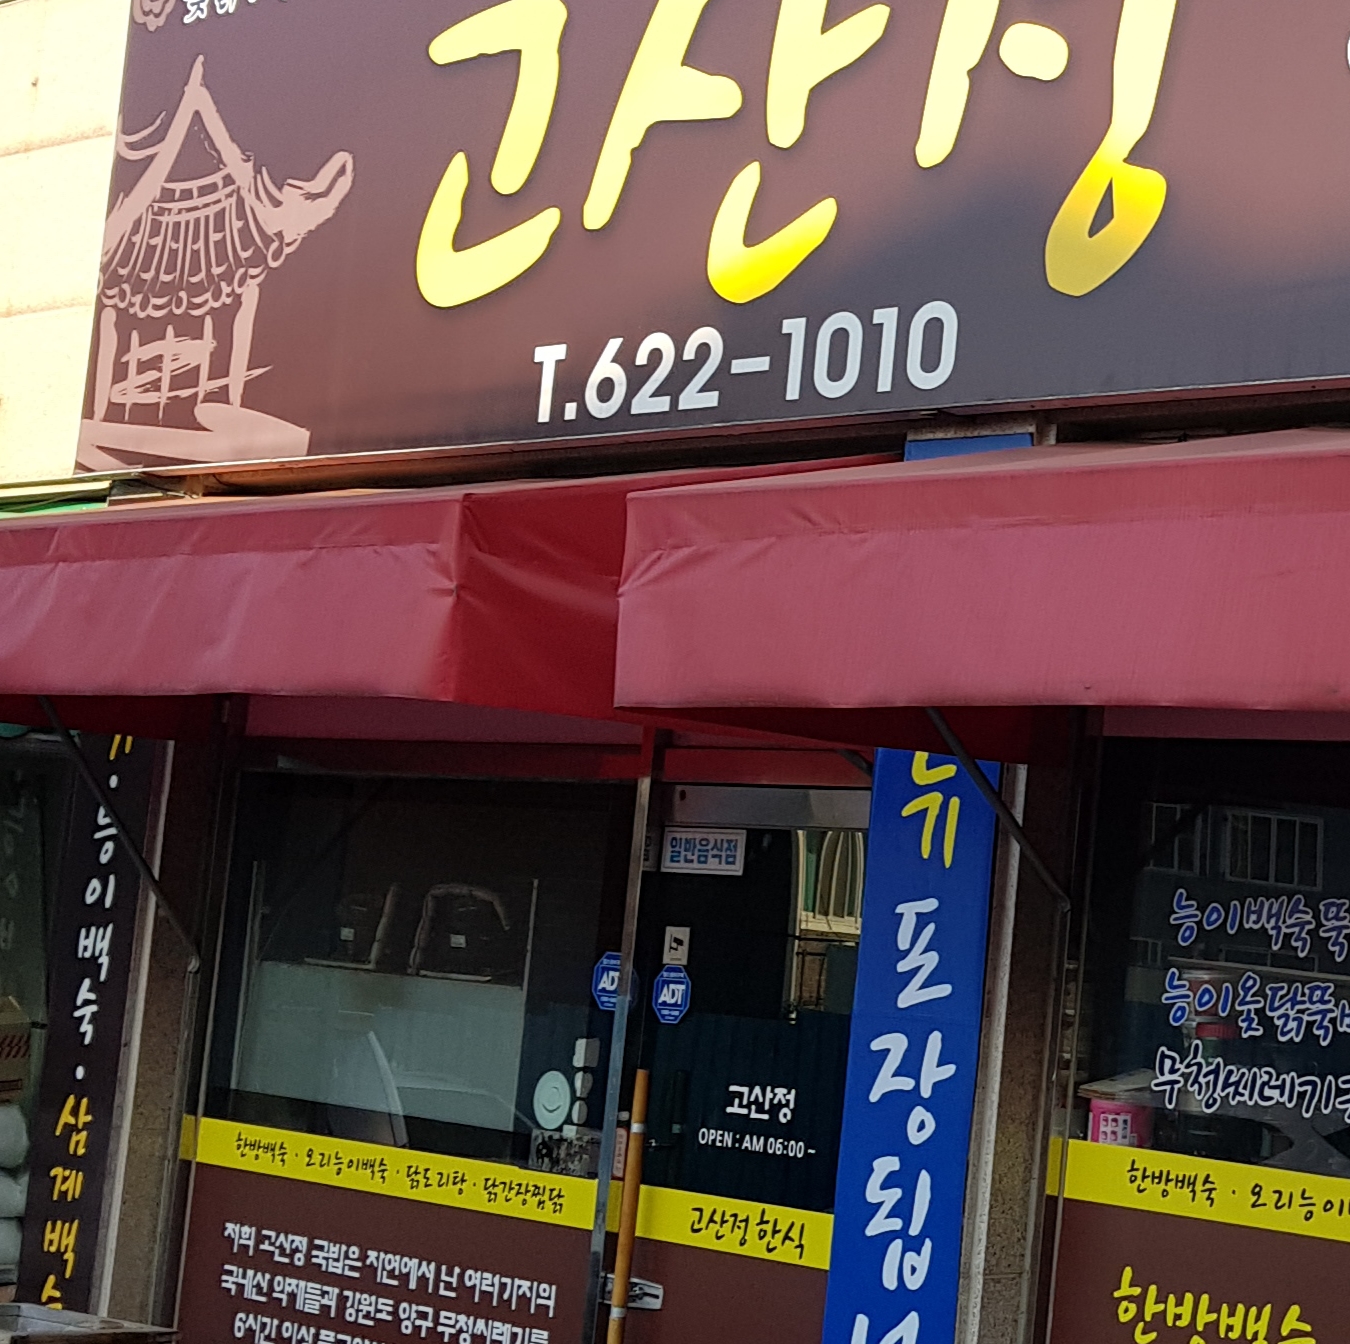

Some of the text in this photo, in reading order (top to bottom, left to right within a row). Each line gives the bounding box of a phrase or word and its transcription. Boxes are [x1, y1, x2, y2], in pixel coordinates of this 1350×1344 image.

[533, 300, 960, 423] T.622-1010
[669, 835, 739, 866] 일반음식점
[658, 983, 686, 1005] ADT
[726, 1084, 796, 1124] 고산정
[235, 1131, 288, 1167] 한방백숙
[306, 1147, 389, 1184] 오리능이백숙
[406, 1164, 468, 1195] 닭도리탕
[698, 1127, 805, 1158] OPEN AM 06:00
[1127, 1159, 1218, 1207] 한방백숙
[690, 1207, 805, 1260] 고산정 한식
[223, 1222, 557, 1318] 저희 고산정 국밥은 자연에서 난 여러가지의
[221, 1264, 271, 1302] 국내산
[272, 1275, 340, 1318] 약재들과
[342, 1290, 395, 1327] 강원도
[398, 1301, 434, 1338] 양구
